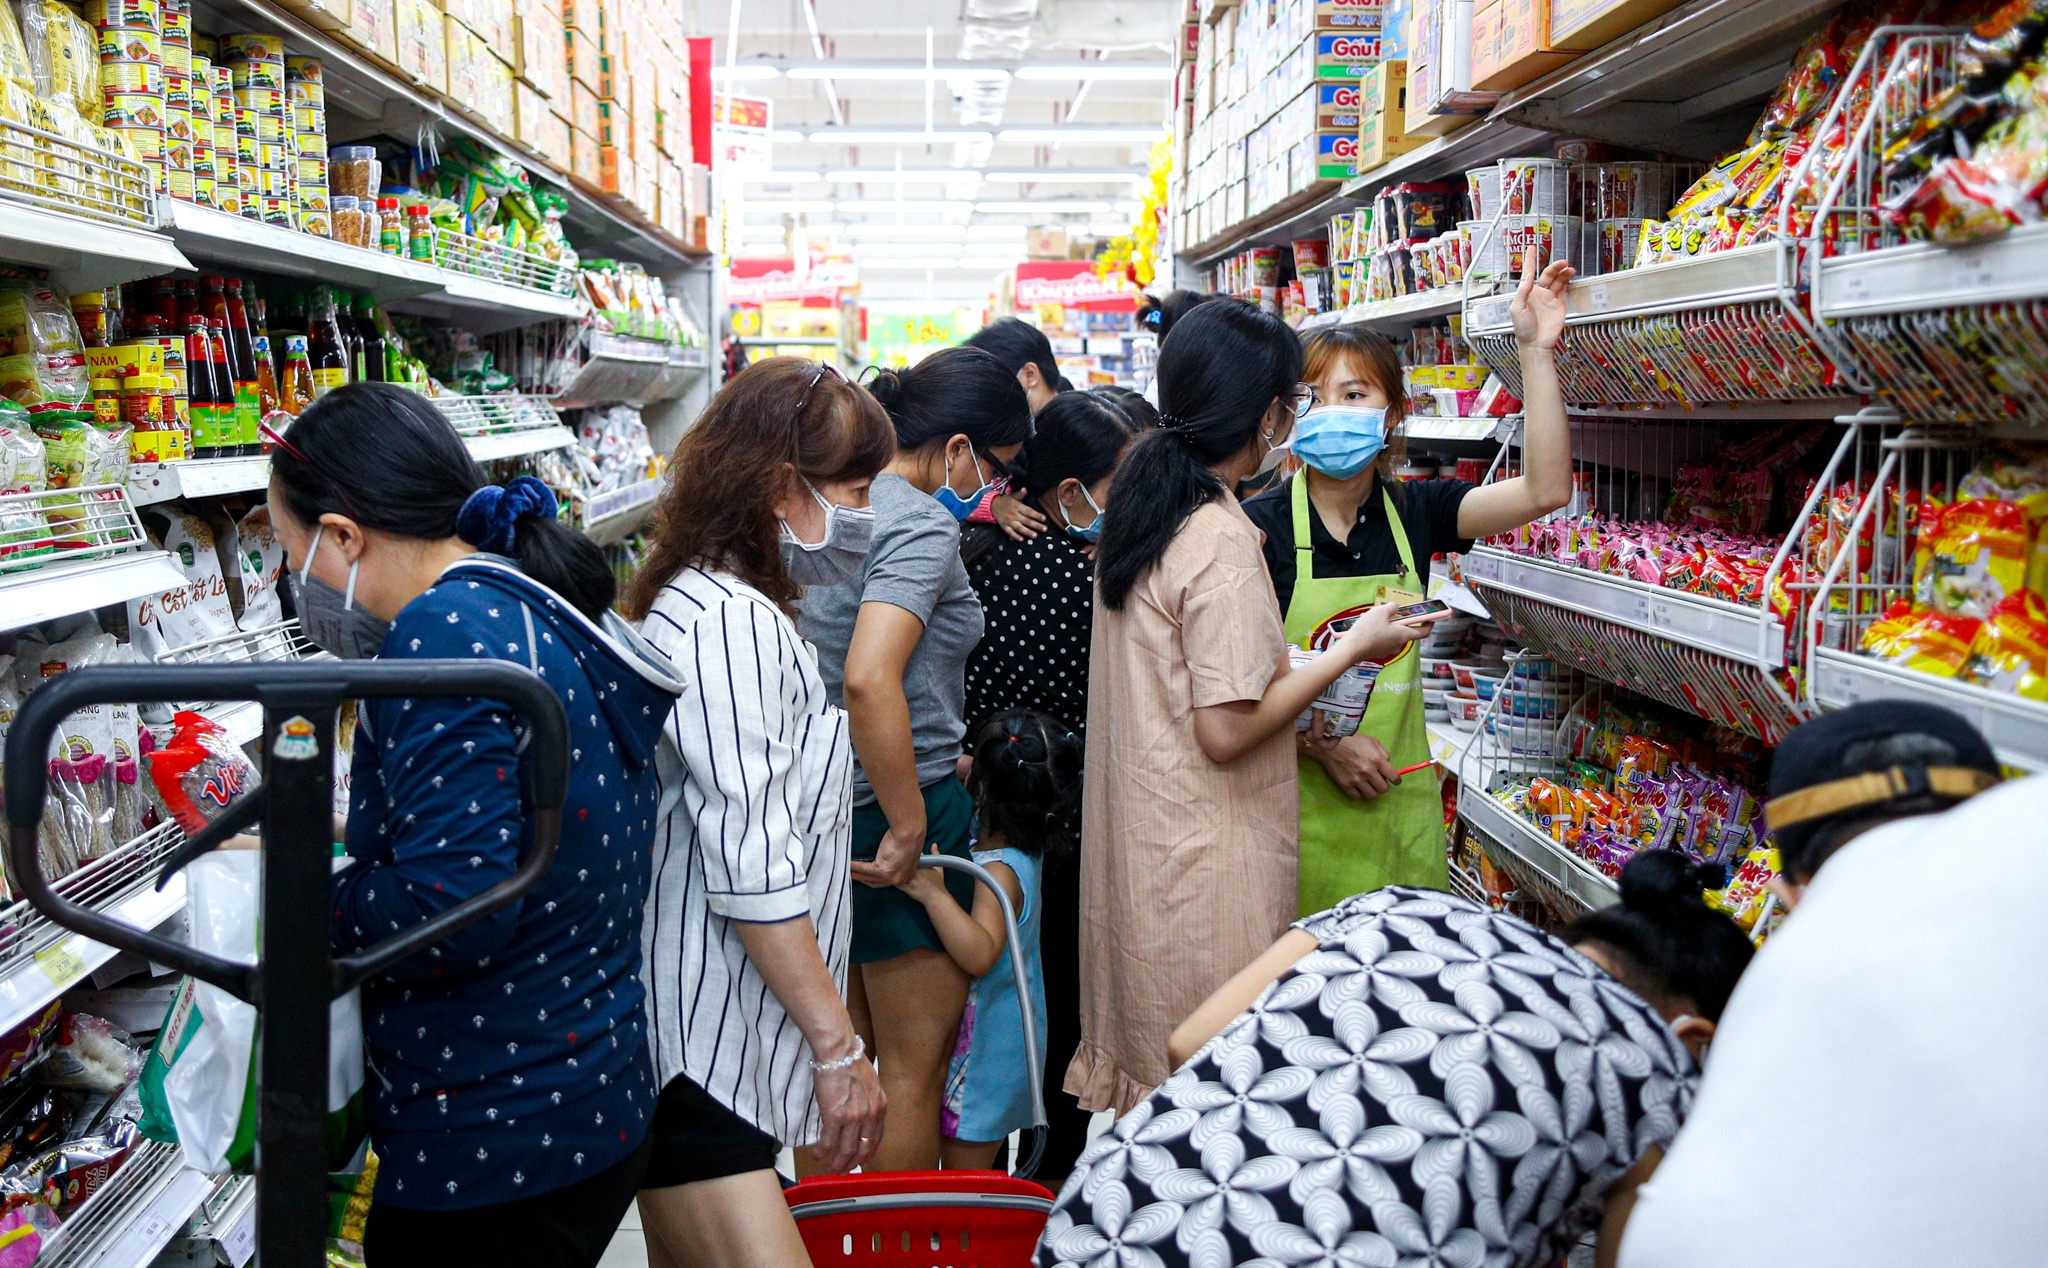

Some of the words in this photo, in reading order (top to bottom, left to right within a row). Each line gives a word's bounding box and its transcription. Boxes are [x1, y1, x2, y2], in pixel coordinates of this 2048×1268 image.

[1503, 233, 1544, 245] IMCHI
[90, 353, 119, 366] NẤM
[1383, 681, 1411, 694] Ngon
